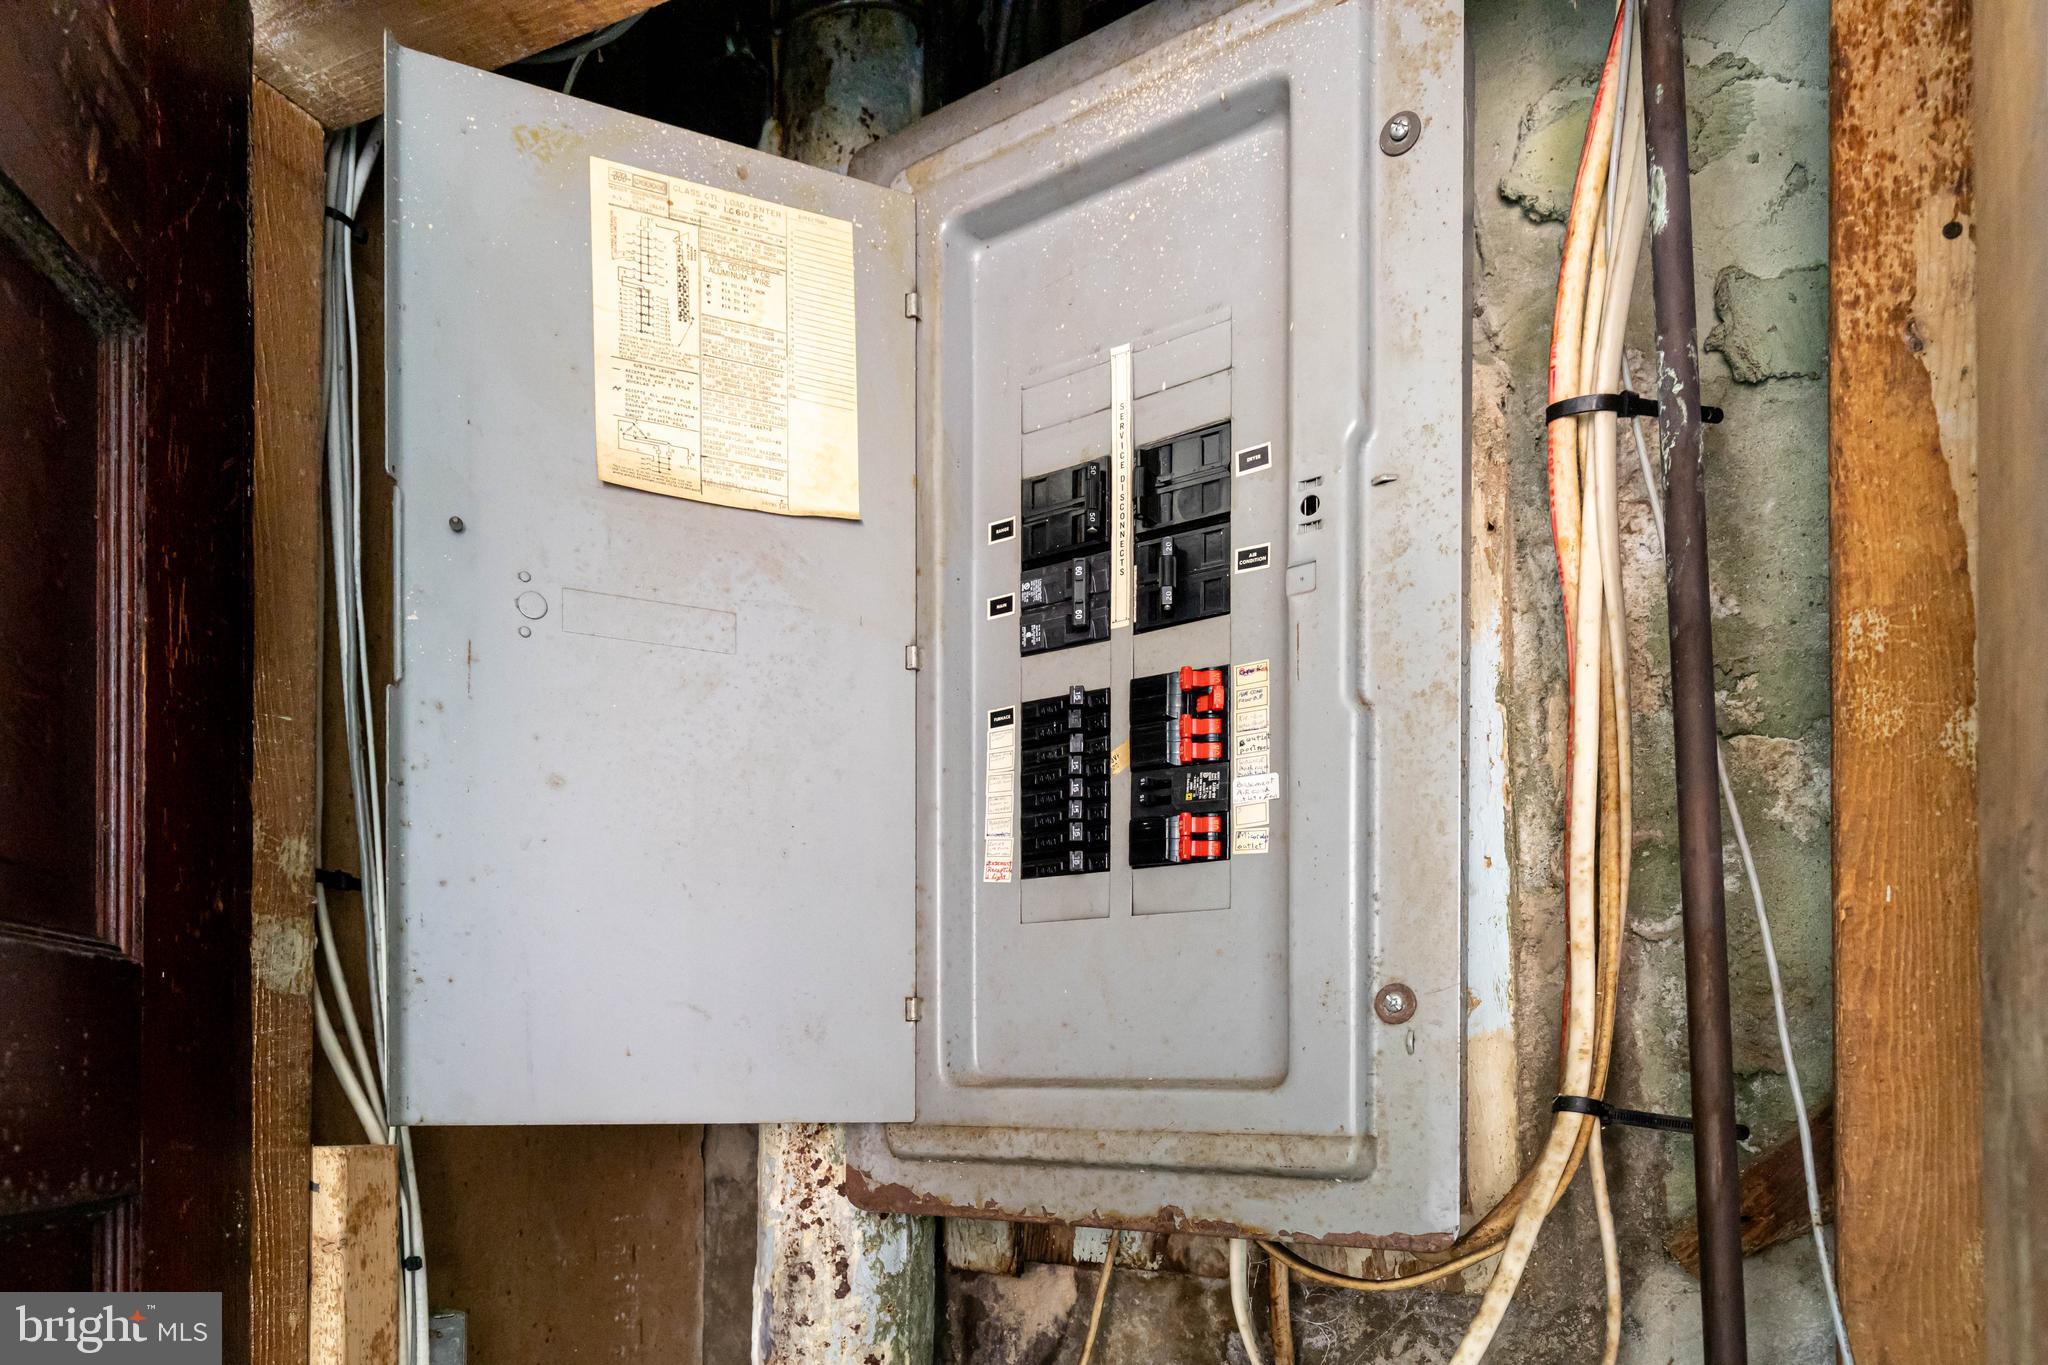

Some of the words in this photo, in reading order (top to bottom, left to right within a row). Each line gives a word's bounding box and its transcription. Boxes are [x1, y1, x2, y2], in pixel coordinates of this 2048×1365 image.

[724, 198, 744, 208] LOAD
[709, 266, 747, 281] ALUMINUM
[1090, 465, 1096, 475] 50
[1089, 512, 1096, 522] 50
[1165, 541, 1172, 552] 20
[1239, 556, 1266, 565] CONDITION
[1248, 551, 1257, 560] AIR
[1075, 566, 1082, 576] 60
[1165, 590, 1172, 601] 20
[1075, 609, 1082, 619] 60
[994, 714, 1011, 722] FURNACE
[1072, 761, 1079, 770] 15
